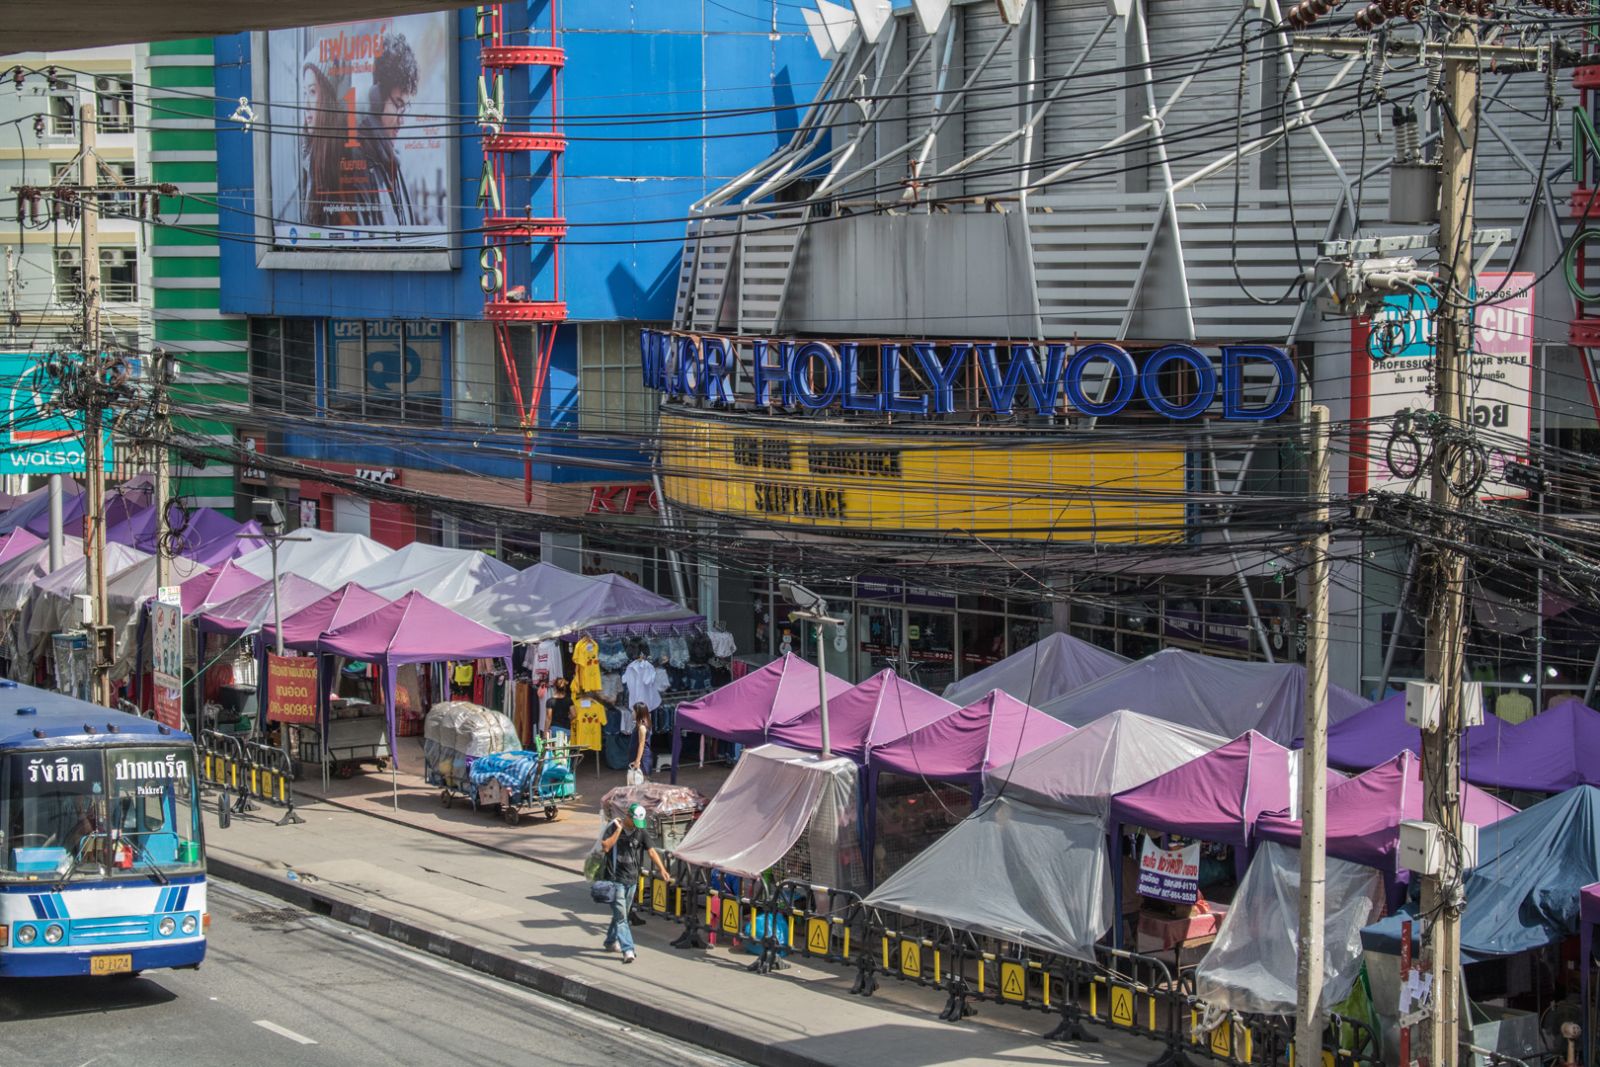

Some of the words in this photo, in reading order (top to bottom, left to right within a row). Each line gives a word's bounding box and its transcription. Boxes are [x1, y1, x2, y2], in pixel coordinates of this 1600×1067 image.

[319, 24, 386, 63] แฟนเดย์
[343, 87, 361, 148] 1
[1481, 307, 1528, 342] CUT
[753, 336, 1298, 421] HOLLYWOOD
[1497, 356, 1527, 365] STYLE
[754, 481, 847, 518] SKIPTRACE
[28, 756, 85, 783] รังสิต
[115, 753, 188, 780] ปากเกร็ด
